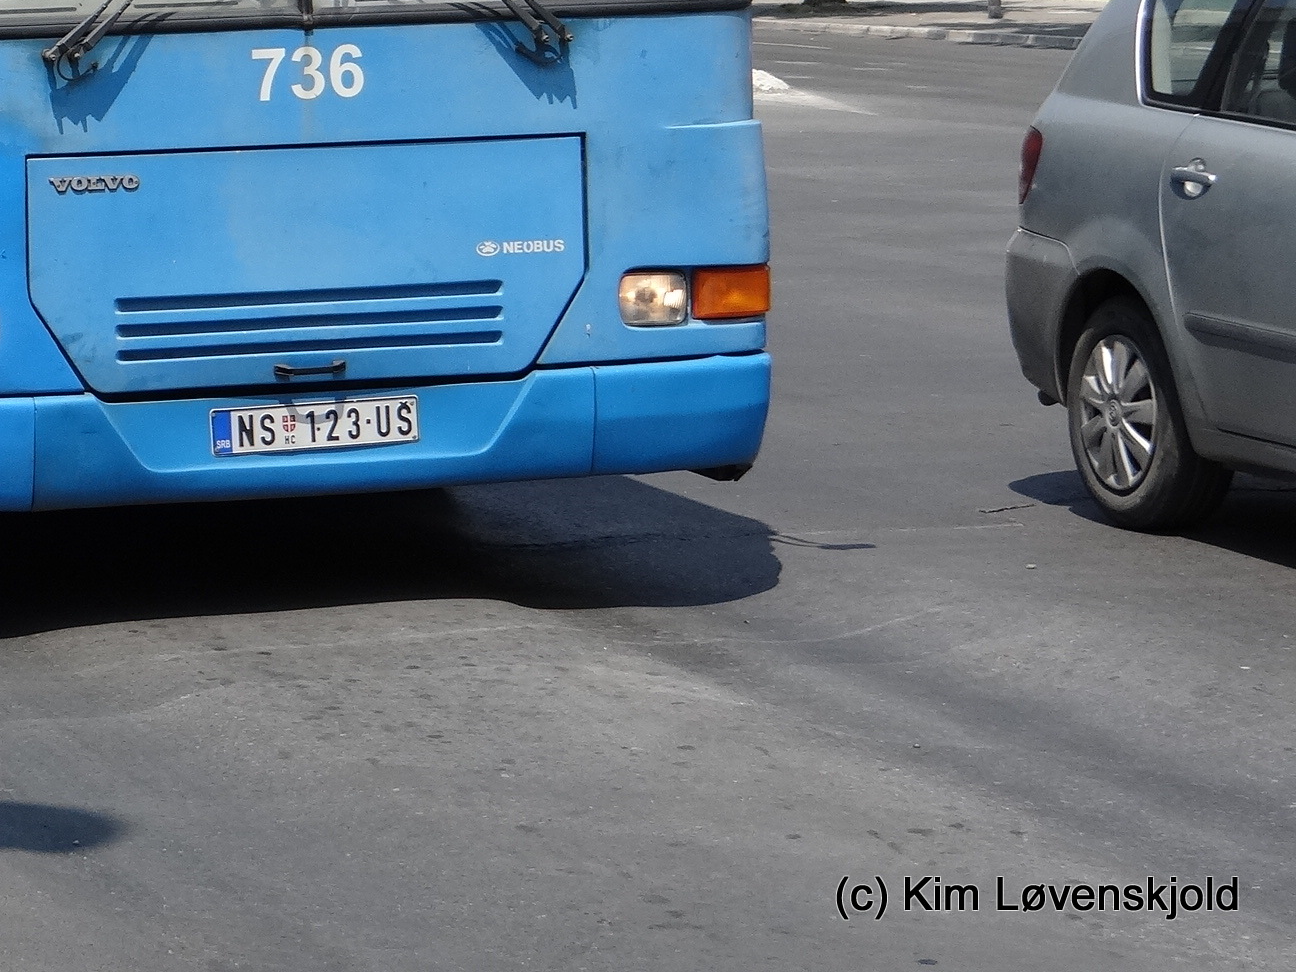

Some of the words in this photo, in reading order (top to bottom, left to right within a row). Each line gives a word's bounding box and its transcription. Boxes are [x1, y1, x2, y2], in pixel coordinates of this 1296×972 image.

[251, 43, 365, 102] 736
[48, 174, 141, 194] VOLVO
[502, 239, 565, 254] NEOBUS
[237, 413, 276, 447] NS
[215, 439, 231, 449] SRB
